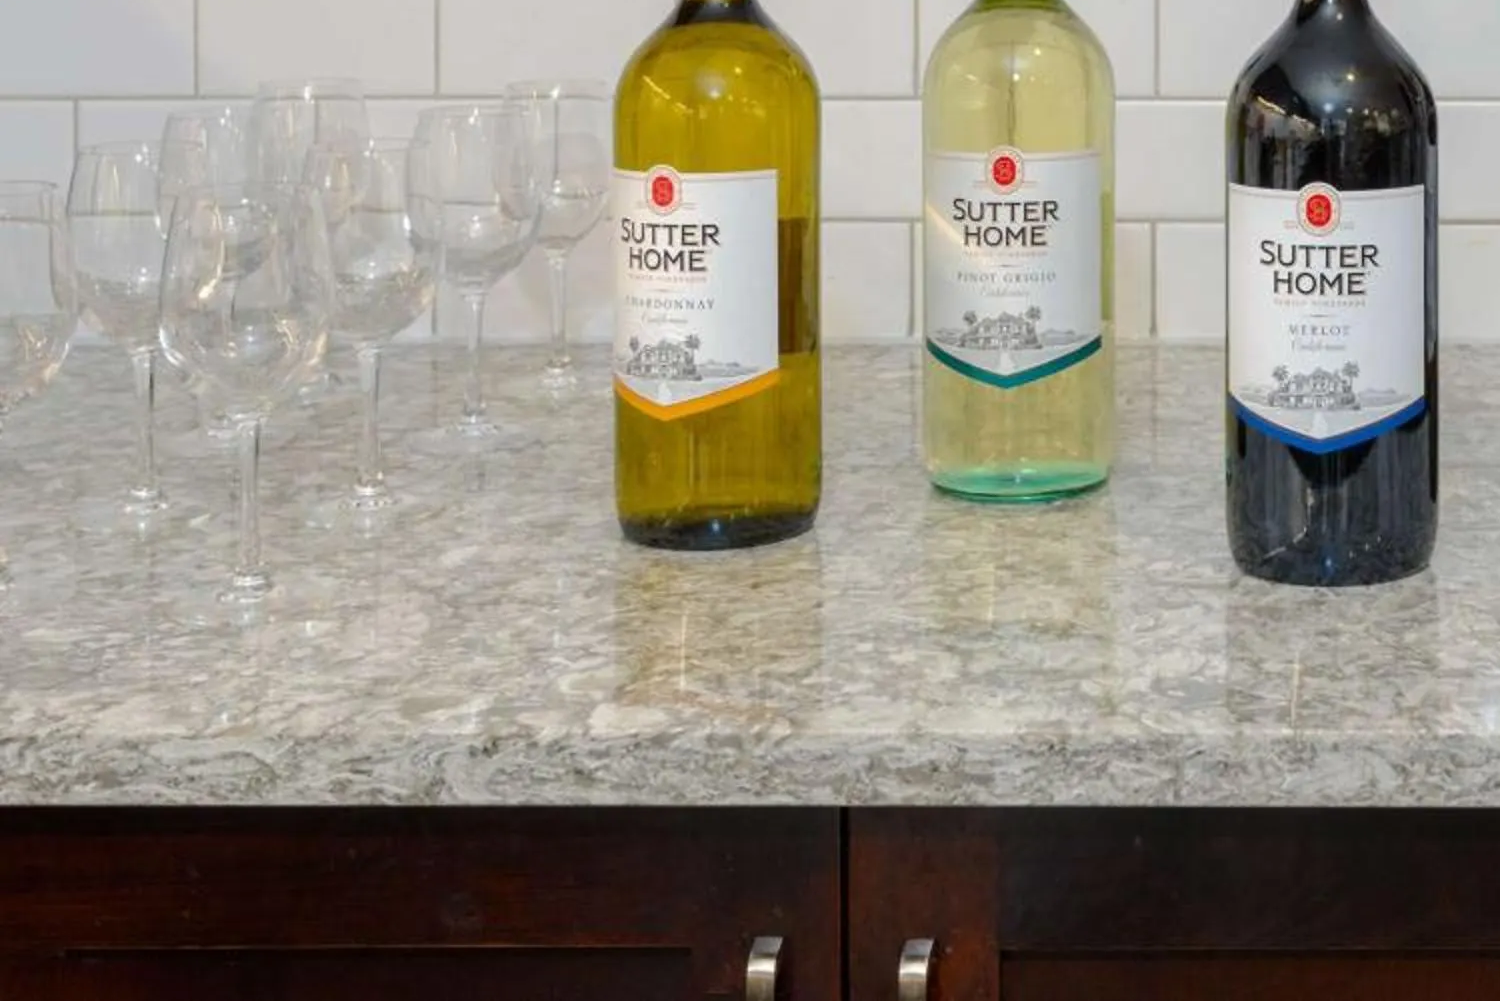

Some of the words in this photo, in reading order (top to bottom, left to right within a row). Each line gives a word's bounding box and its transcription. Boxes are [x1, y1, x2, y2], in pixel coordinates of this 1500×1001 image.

[953, 199, 1059, 222] SUTTER
[621, 218, 721, 246] SUTTER
[964, 225, 1047, 247] HOME
[629, 247, 708, 272] HOME
[1260, 240, 1380, 268] SUTTER
[1273, 271, 1367, 296] HOME
